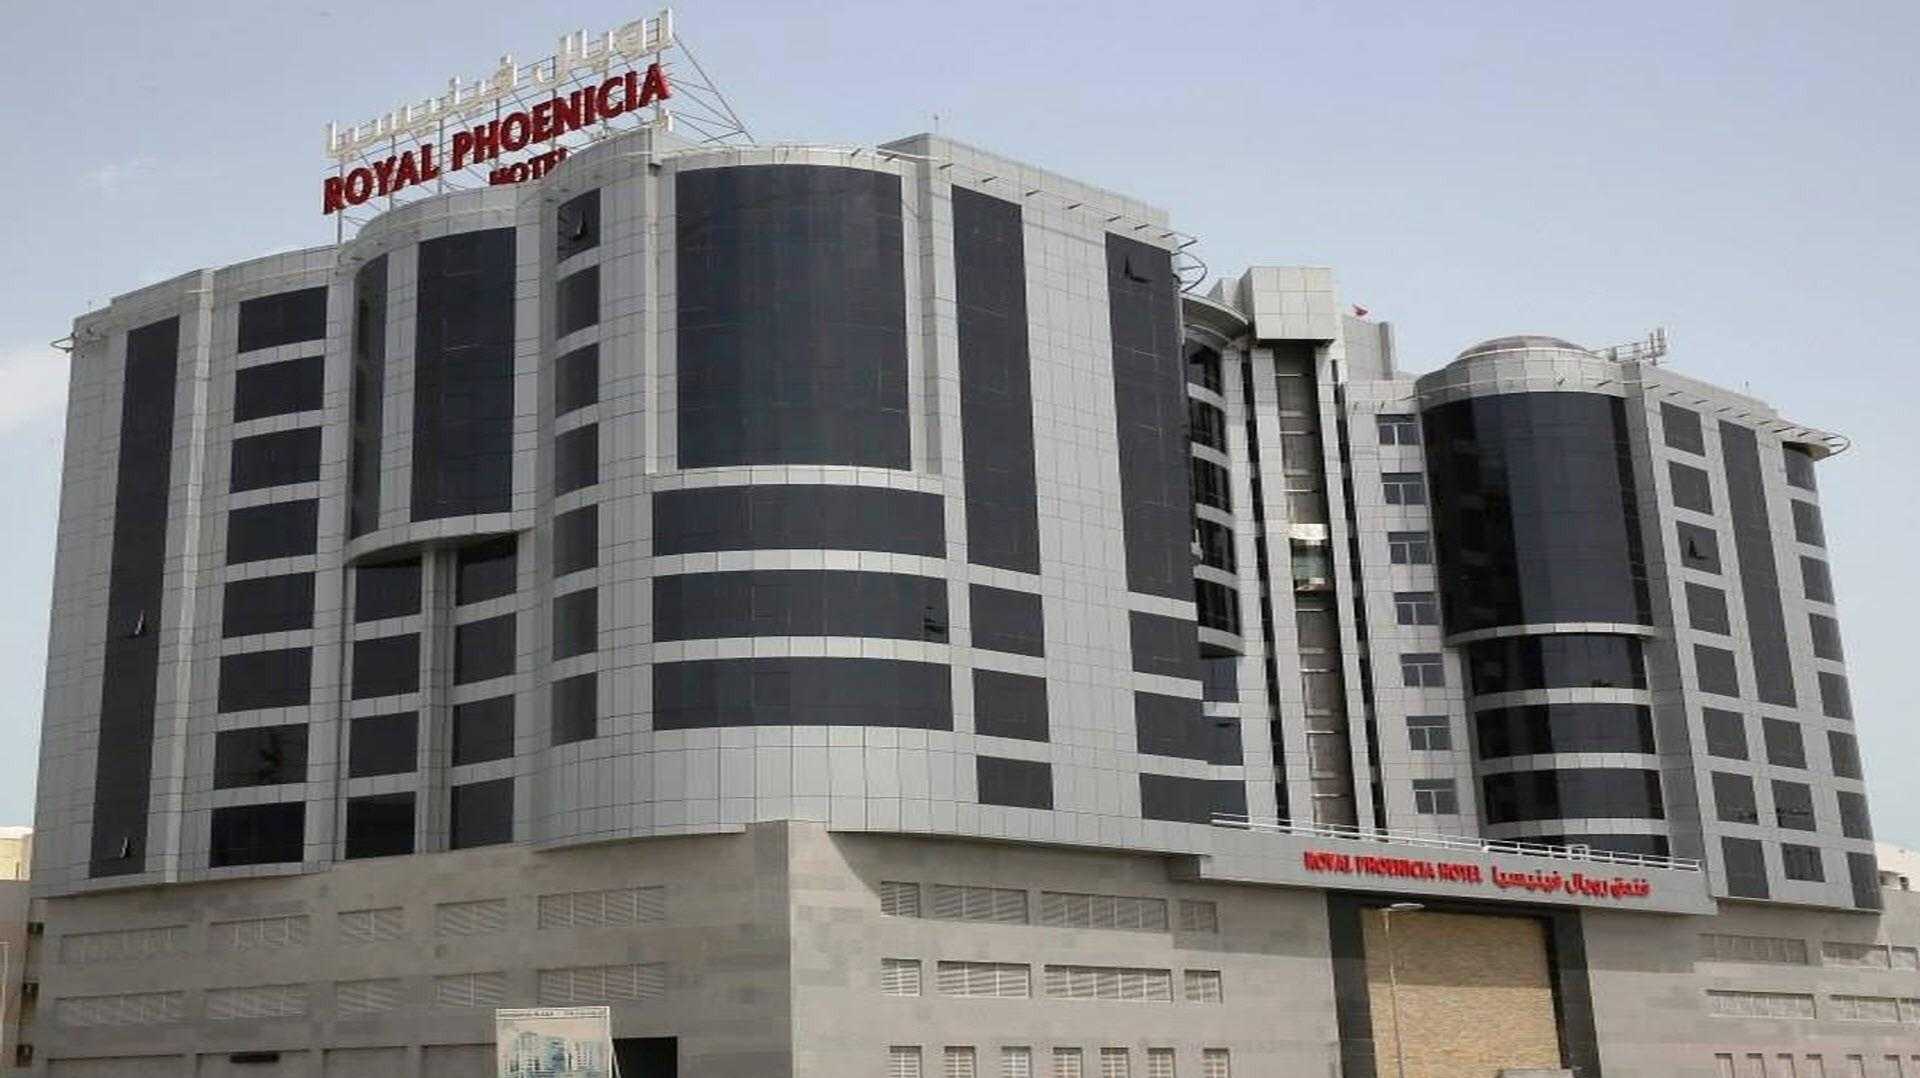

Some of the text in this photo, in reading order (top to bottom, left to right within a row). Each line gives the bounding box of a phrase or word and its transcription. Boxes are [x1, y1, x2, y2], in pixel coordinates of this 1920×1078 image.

[323, 62, 671, 215] ROYAL PHOENICIA
[1304, 851, 1483, 884] ROYAL PHOENICIA HOTEL
[1491, 864, 1563, 894] فينيسيا
[1610, 876, 1650, 901] فندق
